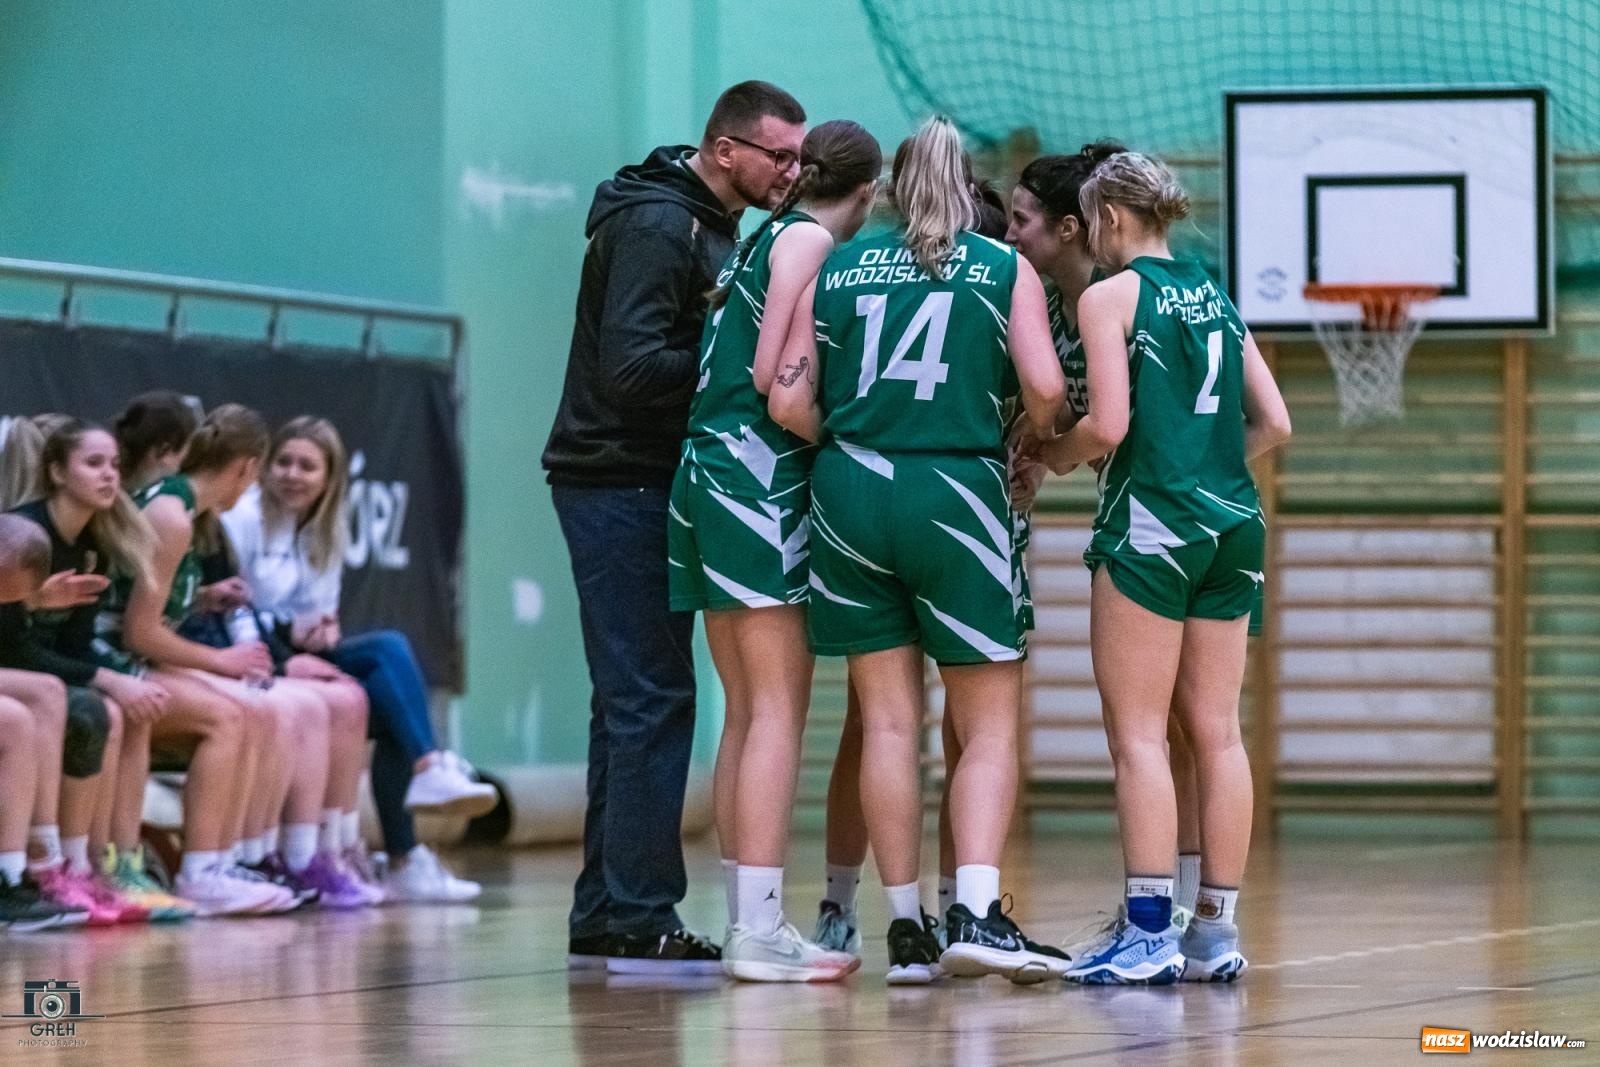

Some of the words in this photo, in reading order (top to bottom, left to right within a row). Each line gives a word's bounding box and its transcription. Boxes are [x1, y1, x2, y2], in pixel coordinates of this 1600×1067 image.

[859, 245, 967, 266] OLIMA
[965, 262, 998, 286] ŚL.
[855, 291, 954, 401] 14
